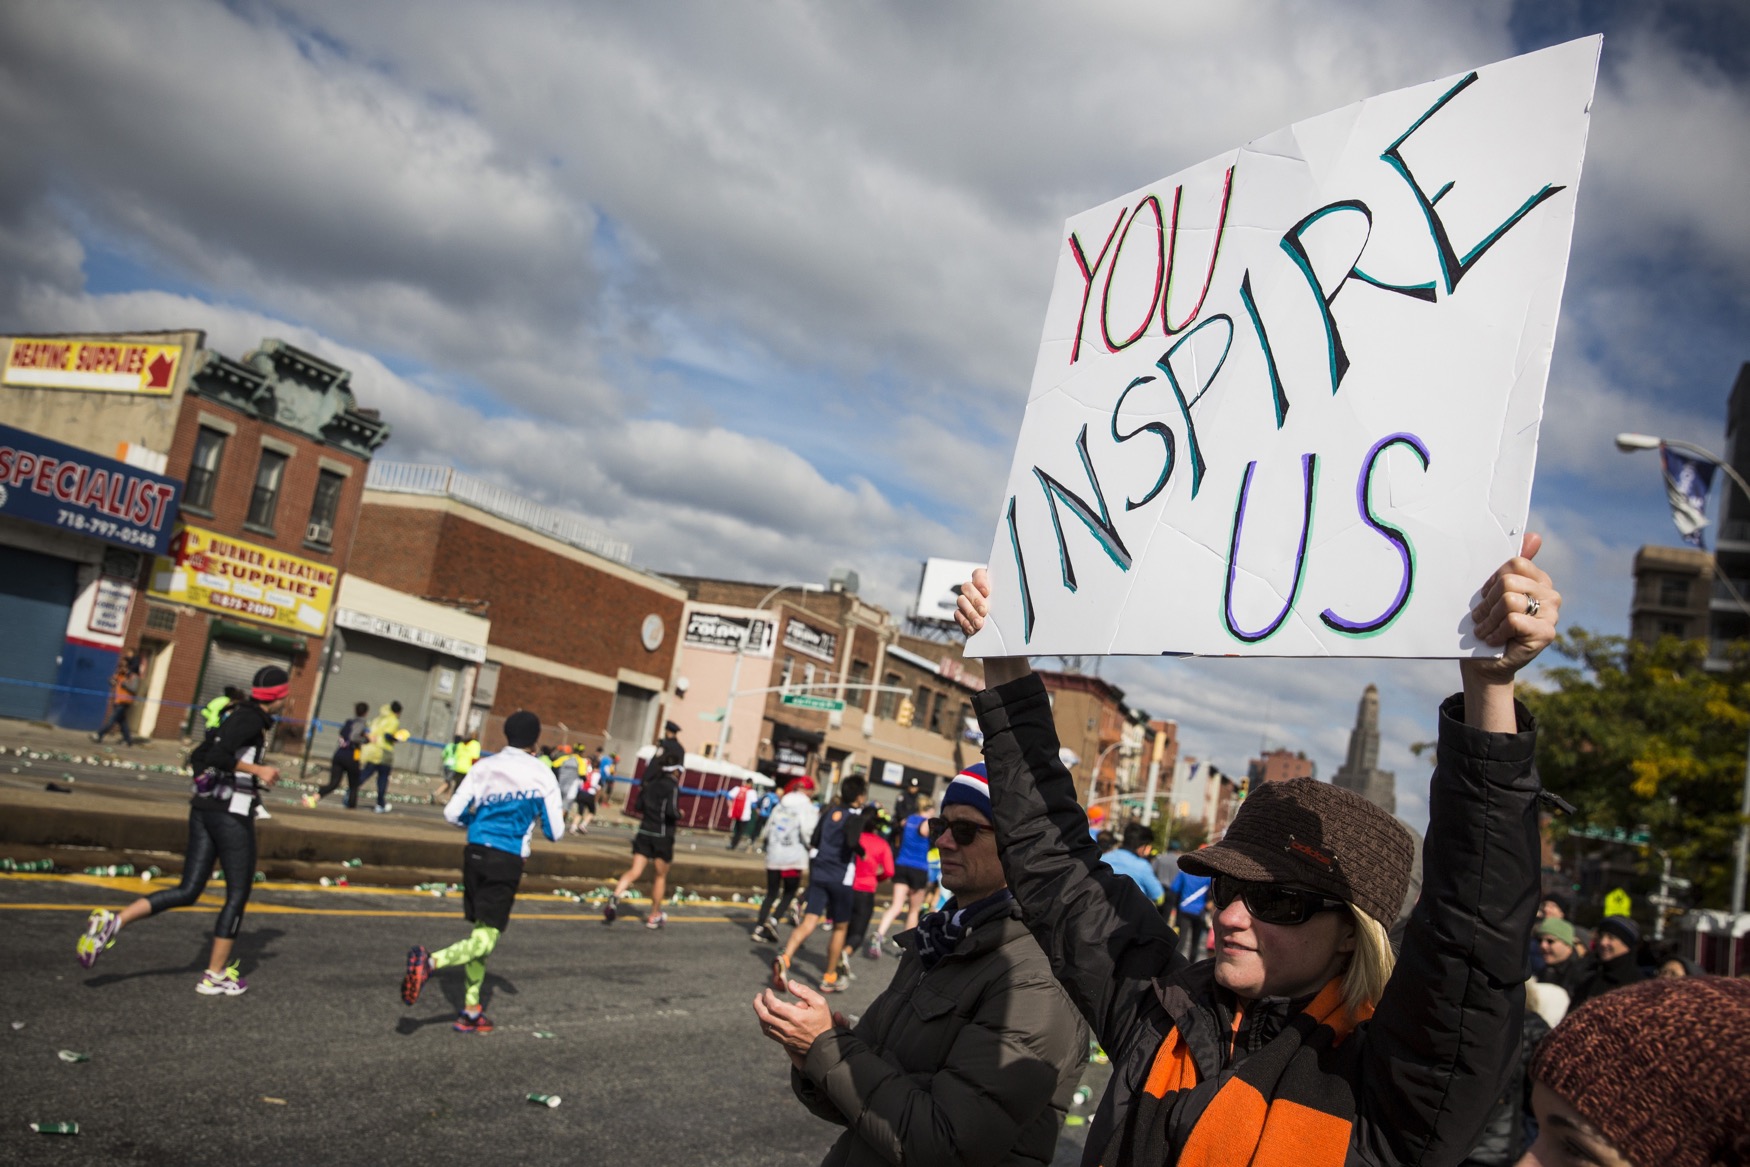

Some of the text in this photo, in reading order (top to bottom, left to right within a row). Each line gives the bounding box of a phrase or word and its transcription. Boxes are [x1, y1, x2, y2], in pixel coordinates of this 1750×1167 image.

[1068, 165, 1236, 365] YOU
[11, 342, 149, 375] HEATING SUPPLIES
[1006, 72, 1566, 644] INSPIRE
[0, 446, 175, 530] SPECIALIST
[209, 538, 265, 567] BURNER
[278, 558, 335, 586] HEATING
[1221, 432, 1431, 645] US
[219, 561, 319, 599] SUPPLIES
[486, 788, 540, 803] GIANT
